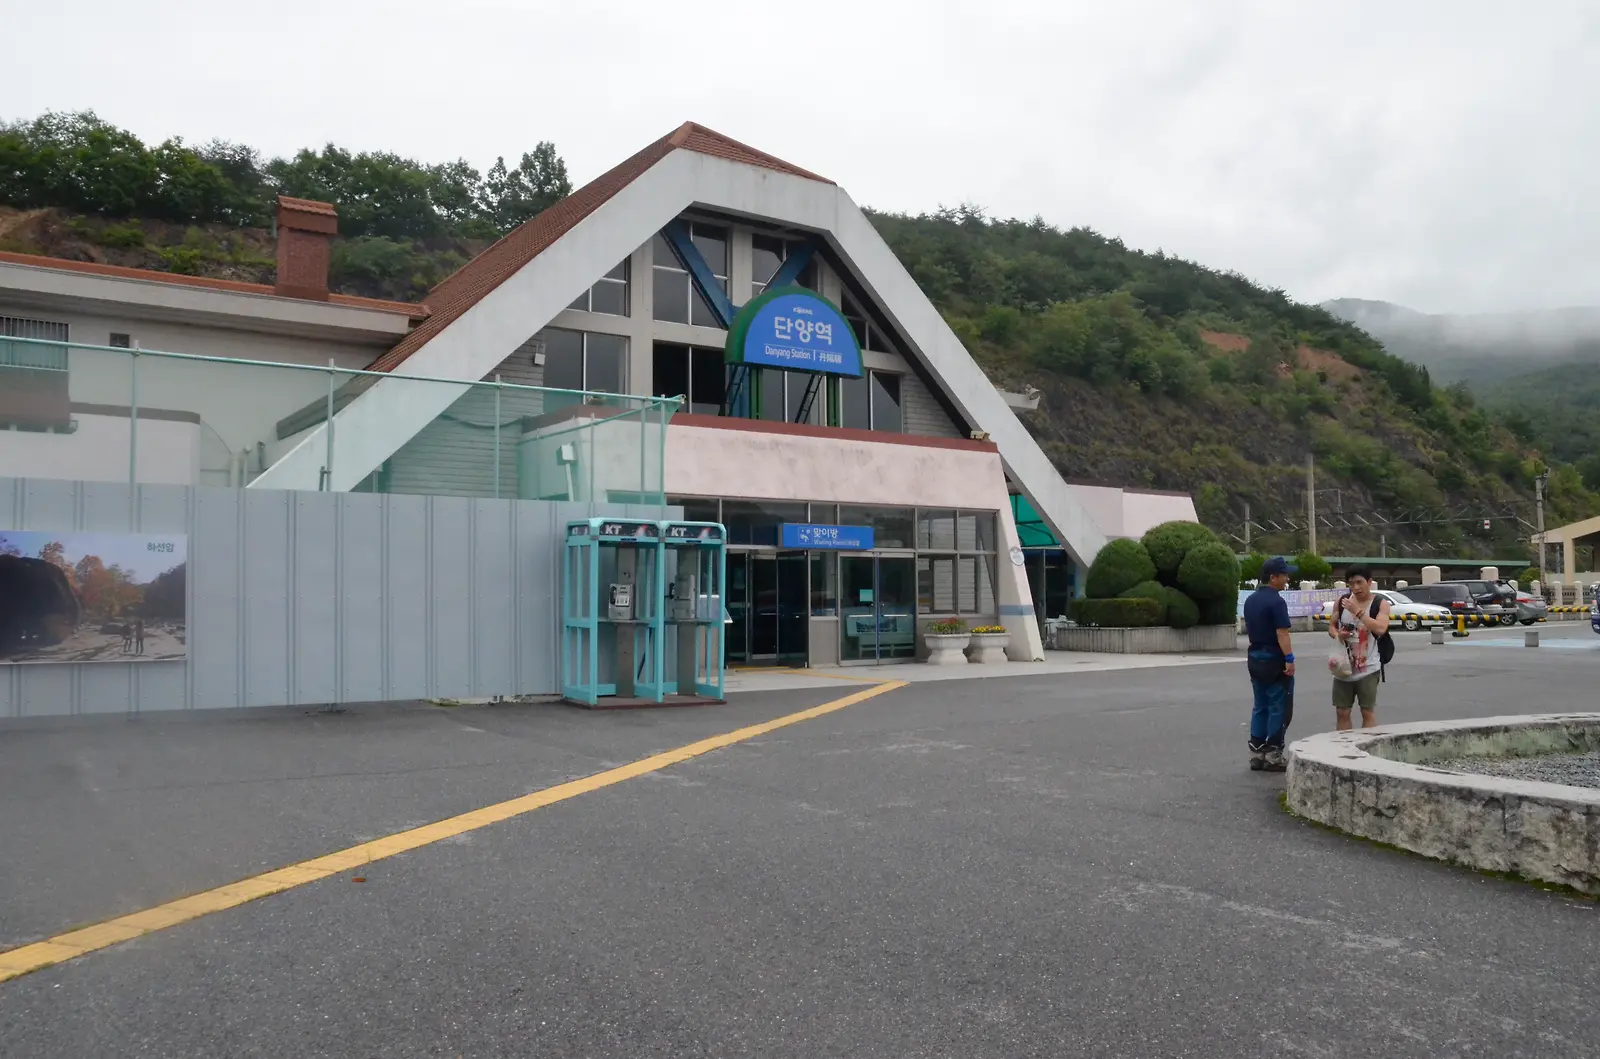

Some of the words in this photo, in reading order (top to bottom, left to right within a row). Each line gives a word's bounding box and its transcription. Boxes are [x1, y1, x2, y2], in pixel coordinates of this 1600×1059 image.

[774, 316, 832, 345] 단양역
[765, 345, 791, 359] Danyang
[791, 348, 811, 359] Station
[605, 524, 622, 535] KT
[671, 527, 687, 537] KT
[813, 527, 838, 539] 맞이방
